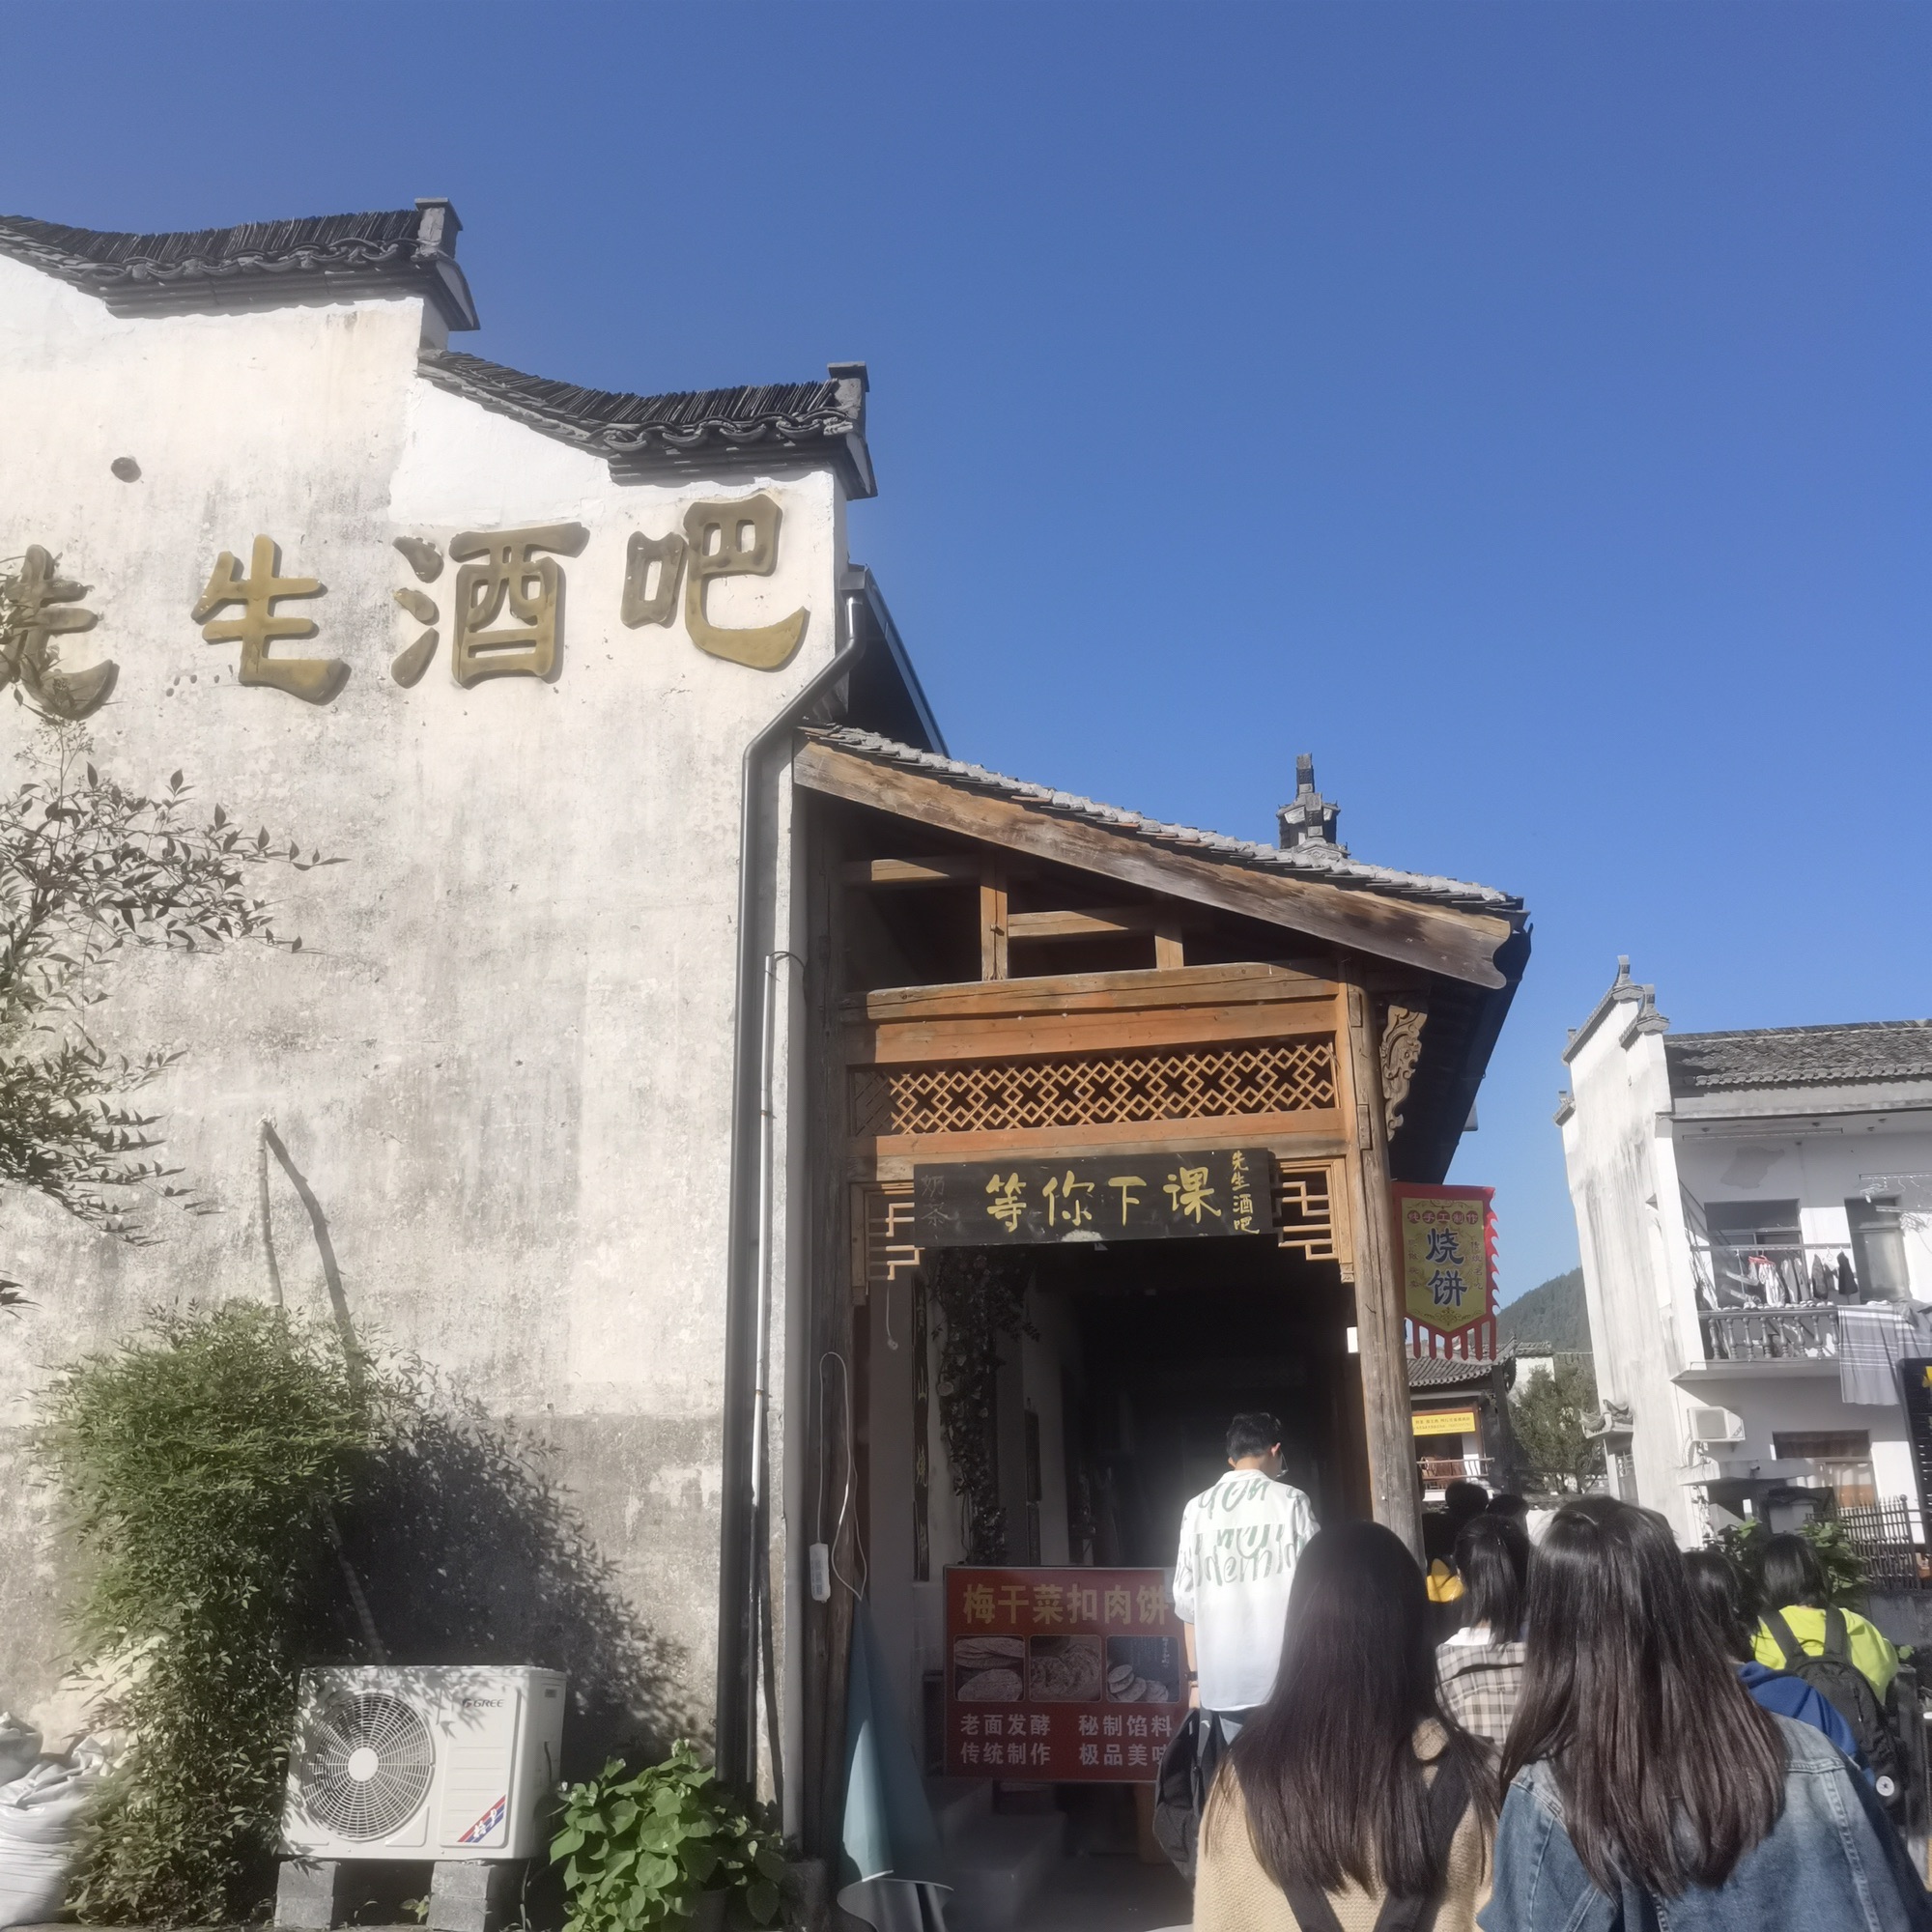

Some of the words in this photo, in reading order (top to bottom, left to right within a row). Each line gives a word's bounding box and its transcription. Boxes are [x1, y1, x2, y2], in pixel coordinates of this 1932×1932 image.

[0, 493, 810, 721] 先生酒吧
[985, 1166, 1222, 1234] 等你下课
[1230, 1150, 1260, 1235] 先生酒吧
[1425, 1228, 1468, 1307] 烧饼
[962, 1582, 1170, 1626] 梅干菜扣肉饼
[471, 1698, 504, 1709] GREE
[959, 1713, 1052, 1737] 老面发酵
[1077, 1714, 1173, 1737] 秘制馅料
[959, 1742, 1052, 1766] 传统制作
